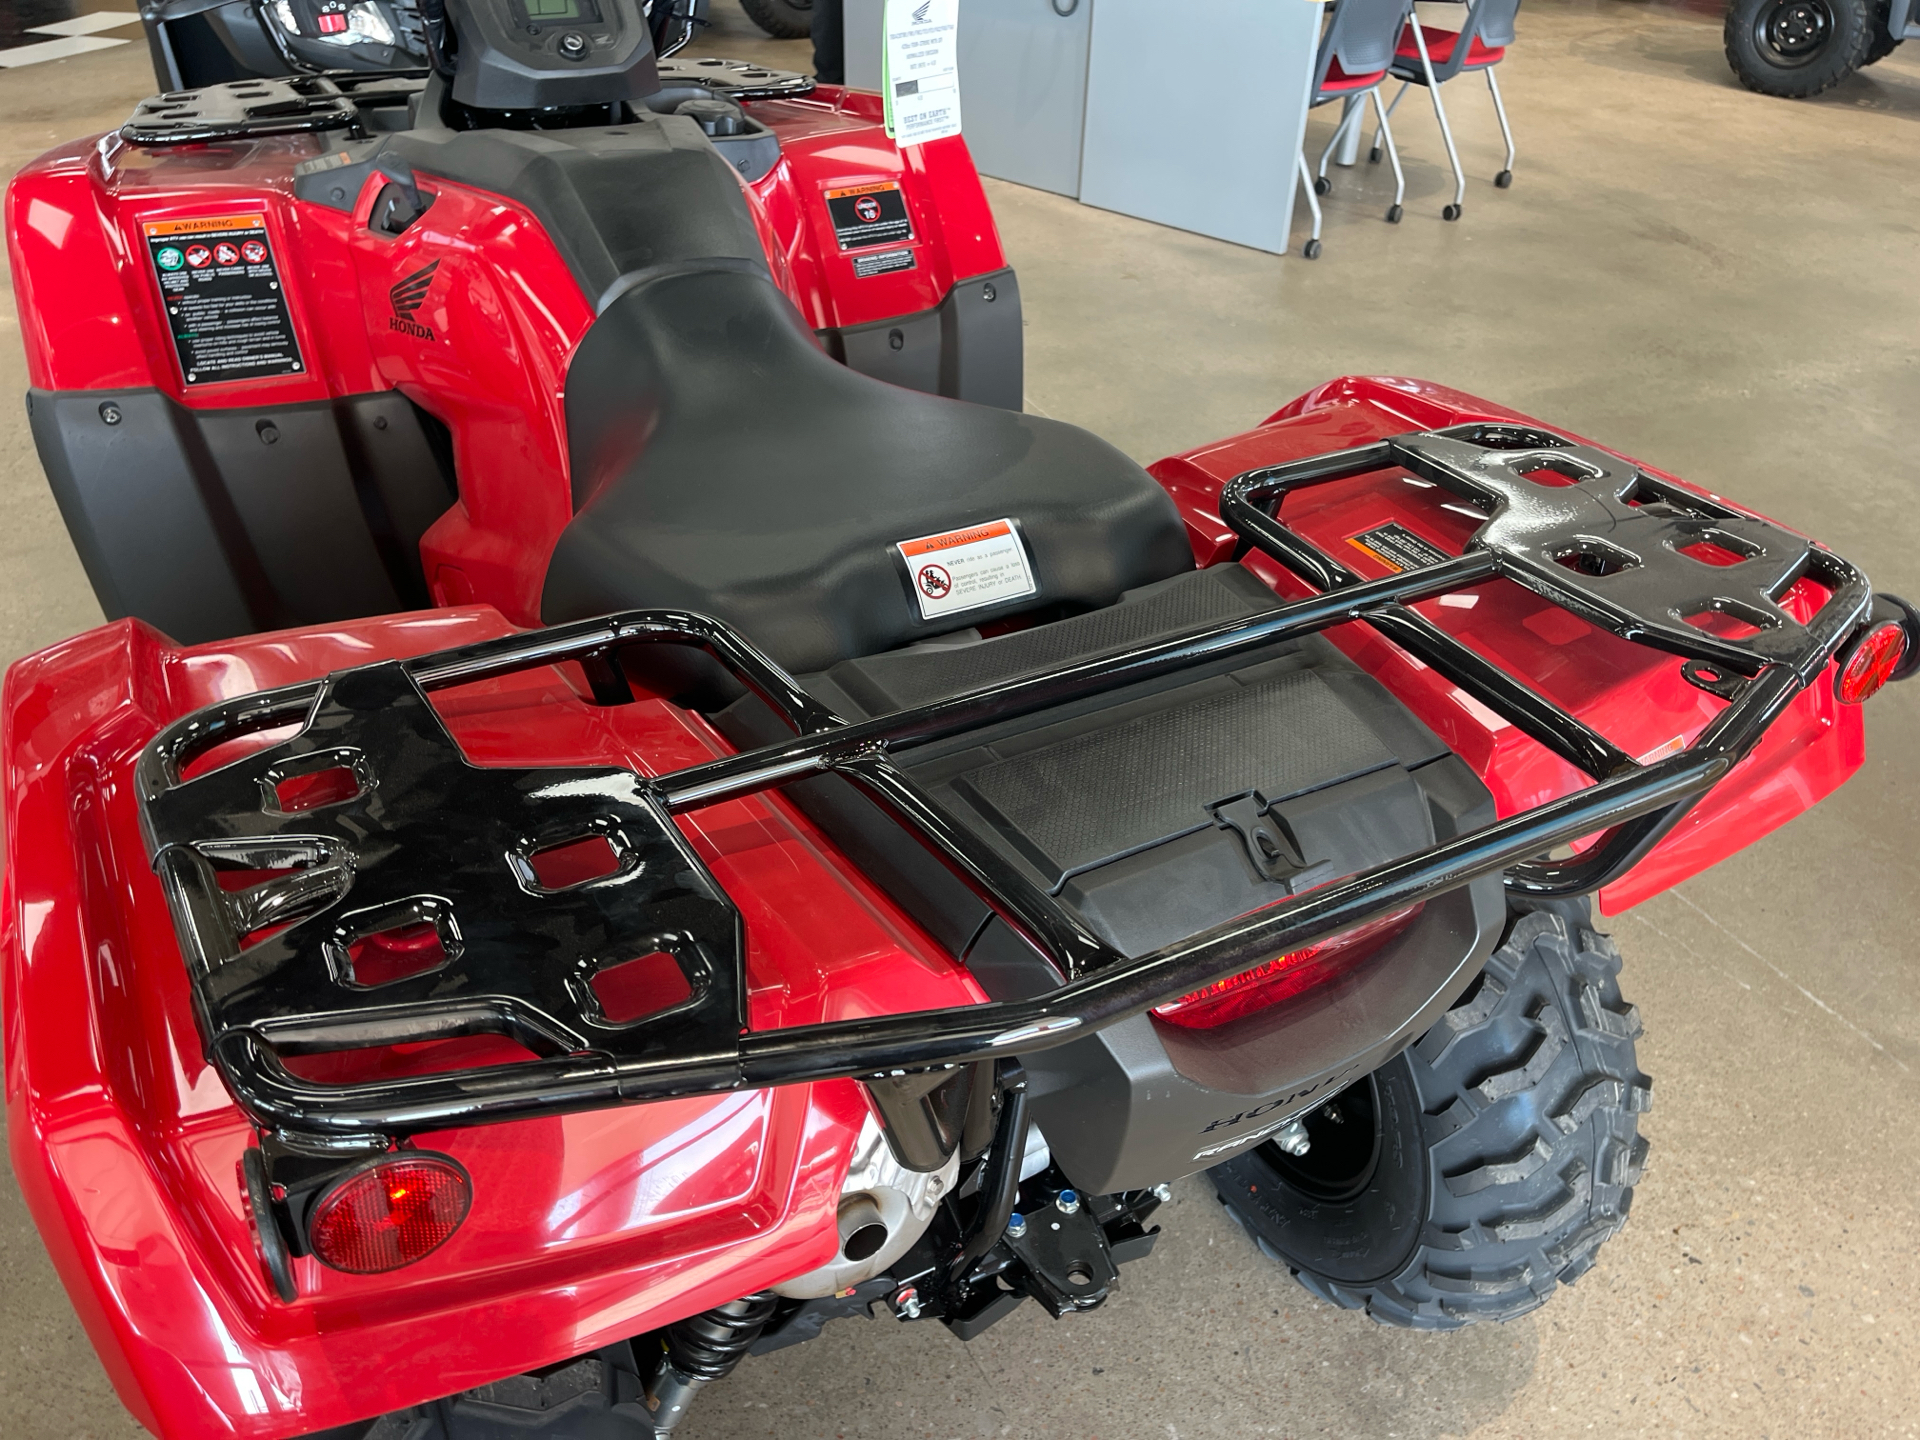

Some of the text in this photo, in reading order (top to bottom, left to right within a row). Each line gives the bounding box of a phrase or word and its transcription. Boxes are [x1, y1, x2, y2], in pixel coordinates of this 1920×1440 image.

[850, 185, 884, 194] WARNING
[864, 210, 876, 219] 16
[183, 220, 233, 230] WARNING
[390, 318, 435, 341] HONDA
[937, 528, 989, 546] WARNING
[952, 572, 978, 583] Passengers
[980, 575, 998, 585] resulting
[956, 587, 976, 596] SEVERE
[978, 581, 996, 591] INJURY
